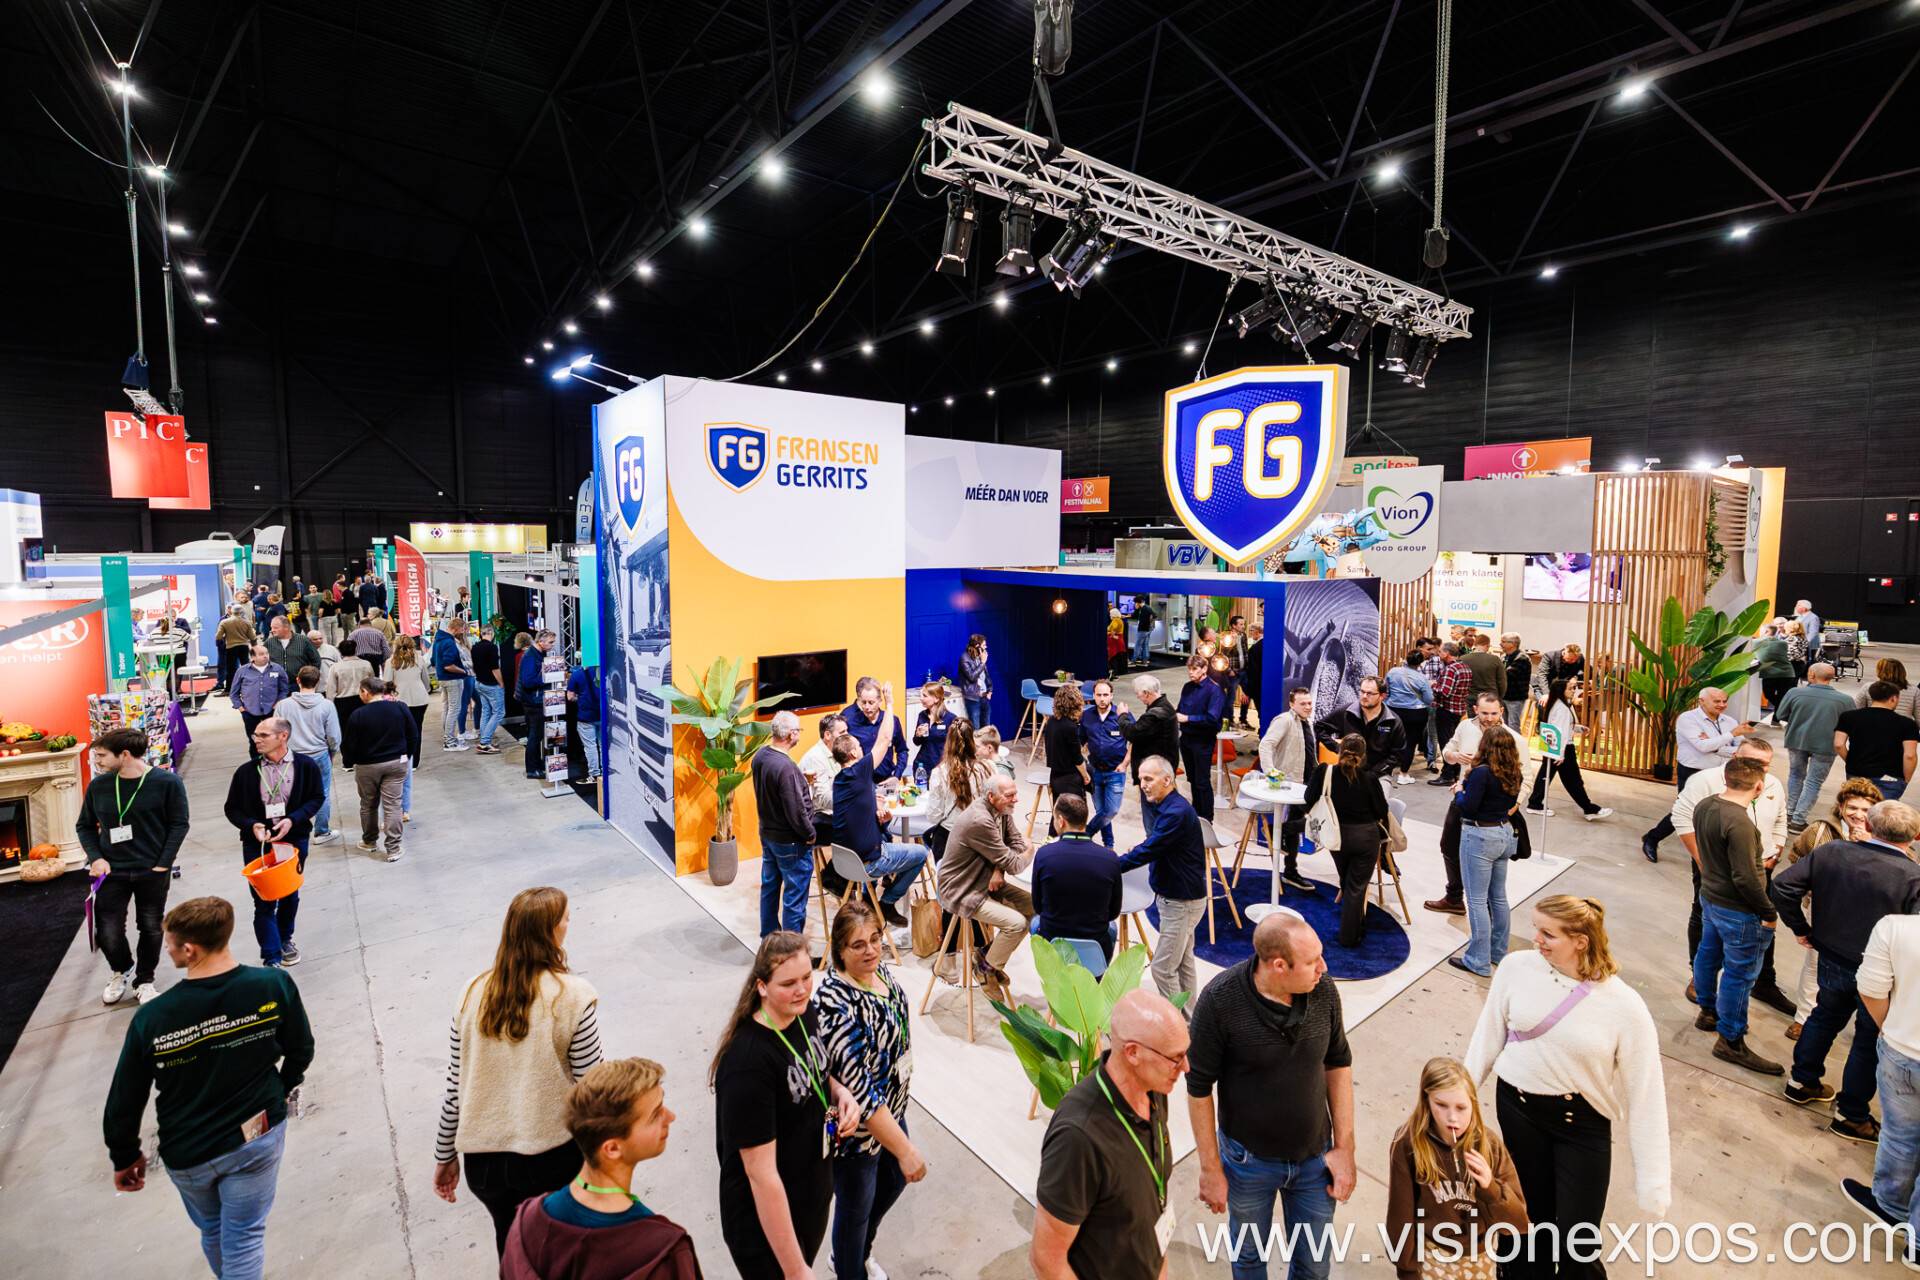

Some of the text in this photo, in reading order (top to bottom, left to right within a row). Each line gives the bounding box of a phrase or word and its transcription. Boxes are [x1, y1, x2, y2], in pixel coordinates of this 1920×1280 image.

[717, 434, 761, 471] FG
[776, 436, 879, 465] FRANSEN
[1194, 401, 1302, 501] FG
[619, 446, 643, 504] FG
[776, 463, 868, 490] GERRITS
[965, 484, 1049, 504] MÉÉR DAN VOER
[1064, 497, 1103, 506] FESTIVALHAL
[1381, 505, 1419, 520] Vion
[1167, 543, 1210, 566] VBV
[1450, 602, 1478, 610] GOOD
[153, 1014, 228, 1046] ACCOMPLISHED
[155, 1032, 200, 1051] THROUGH
[202, 1013, 260, 1035] DEDICATION.
